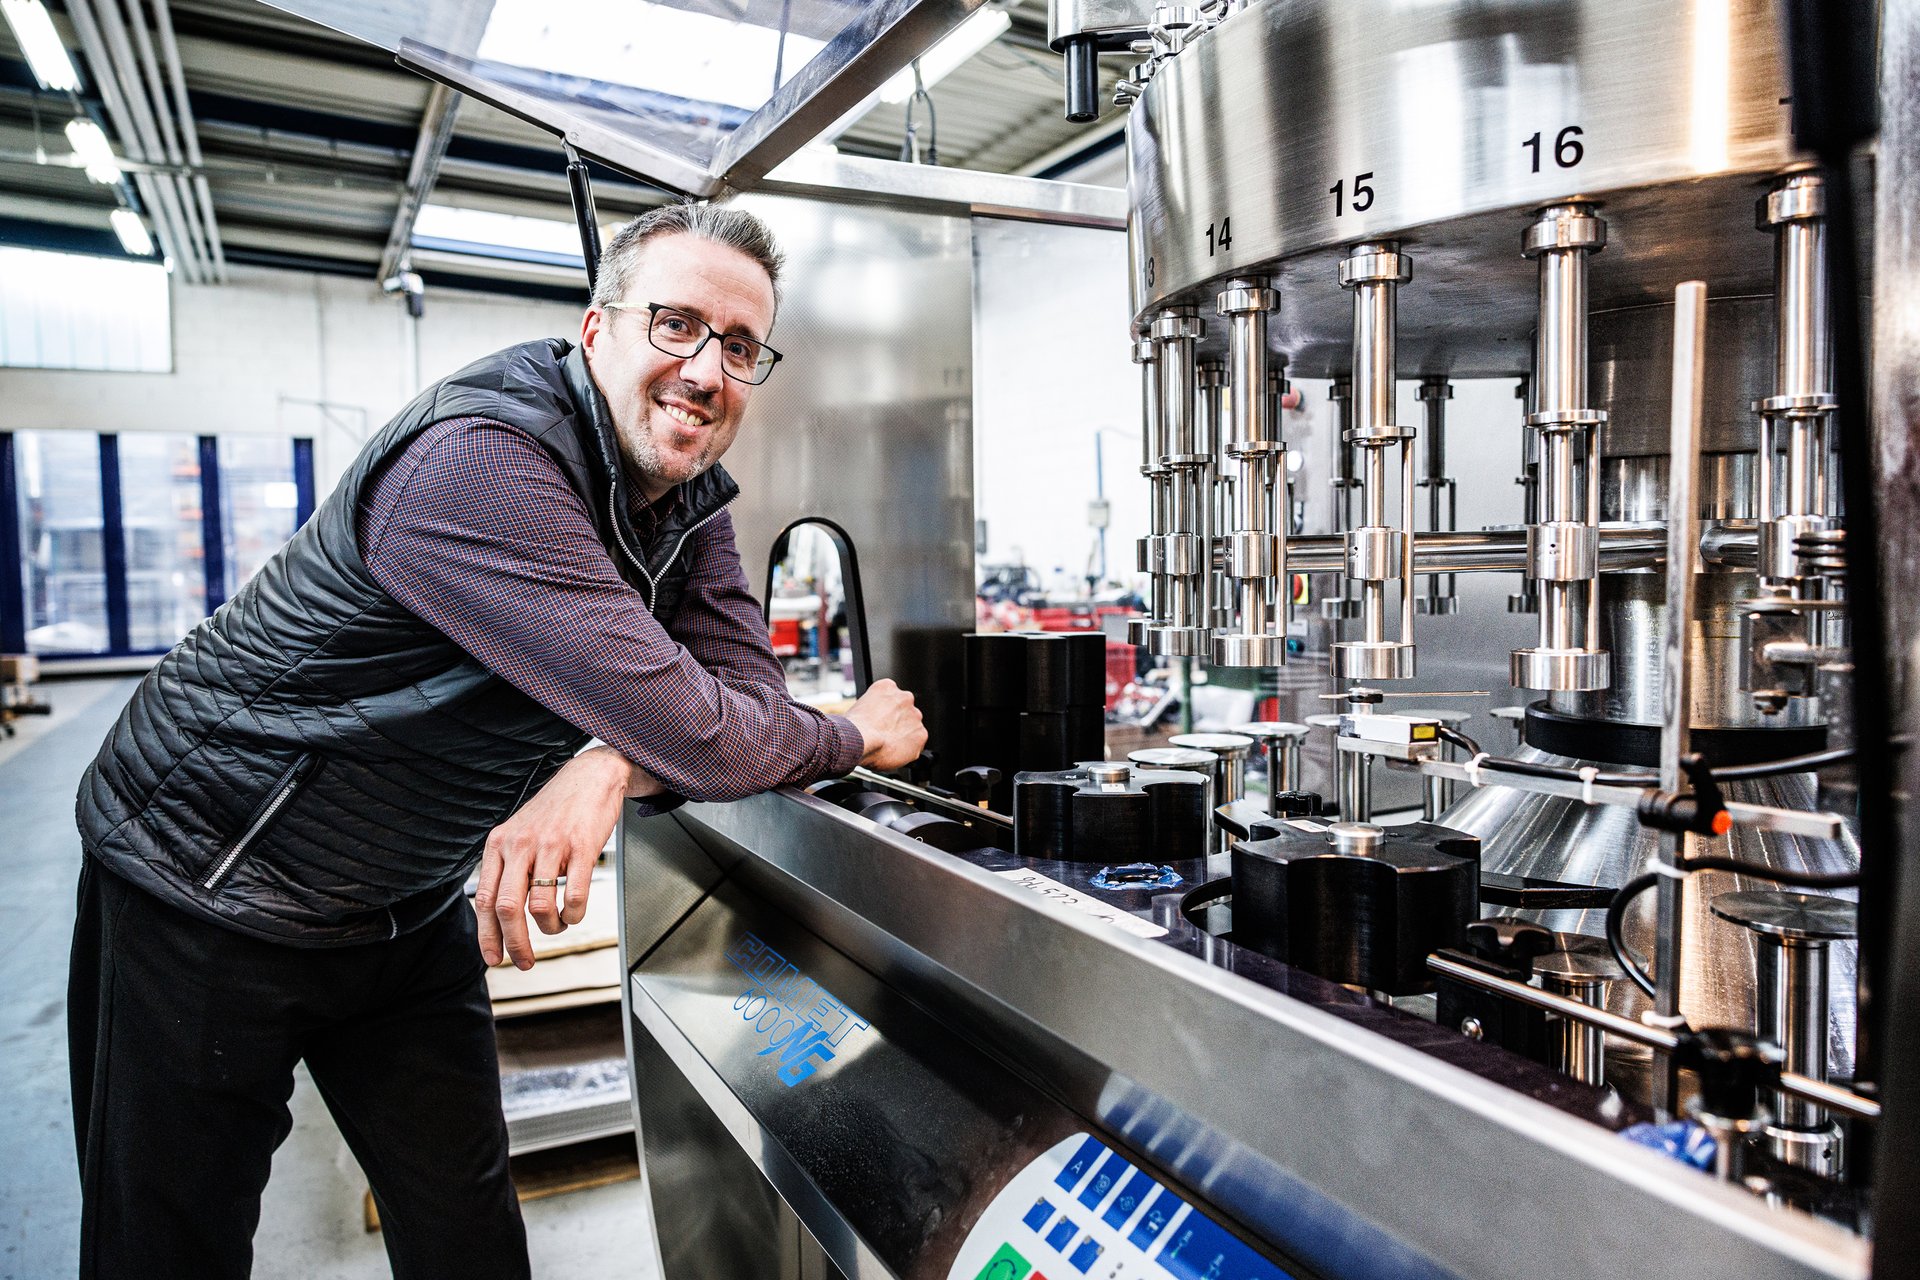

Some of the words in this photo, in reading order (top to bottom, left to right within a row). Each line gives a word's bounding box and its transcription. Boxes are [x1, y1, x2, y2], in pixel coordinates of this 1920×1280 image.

[1522, 126, 1584, 174] 16
[1329, 171, 1374, 217] 15
[1205, 217, 1232, 257] 14
[724, 930, 870, 1048] COMET
[1070, 1160, 1083, 1174] A
